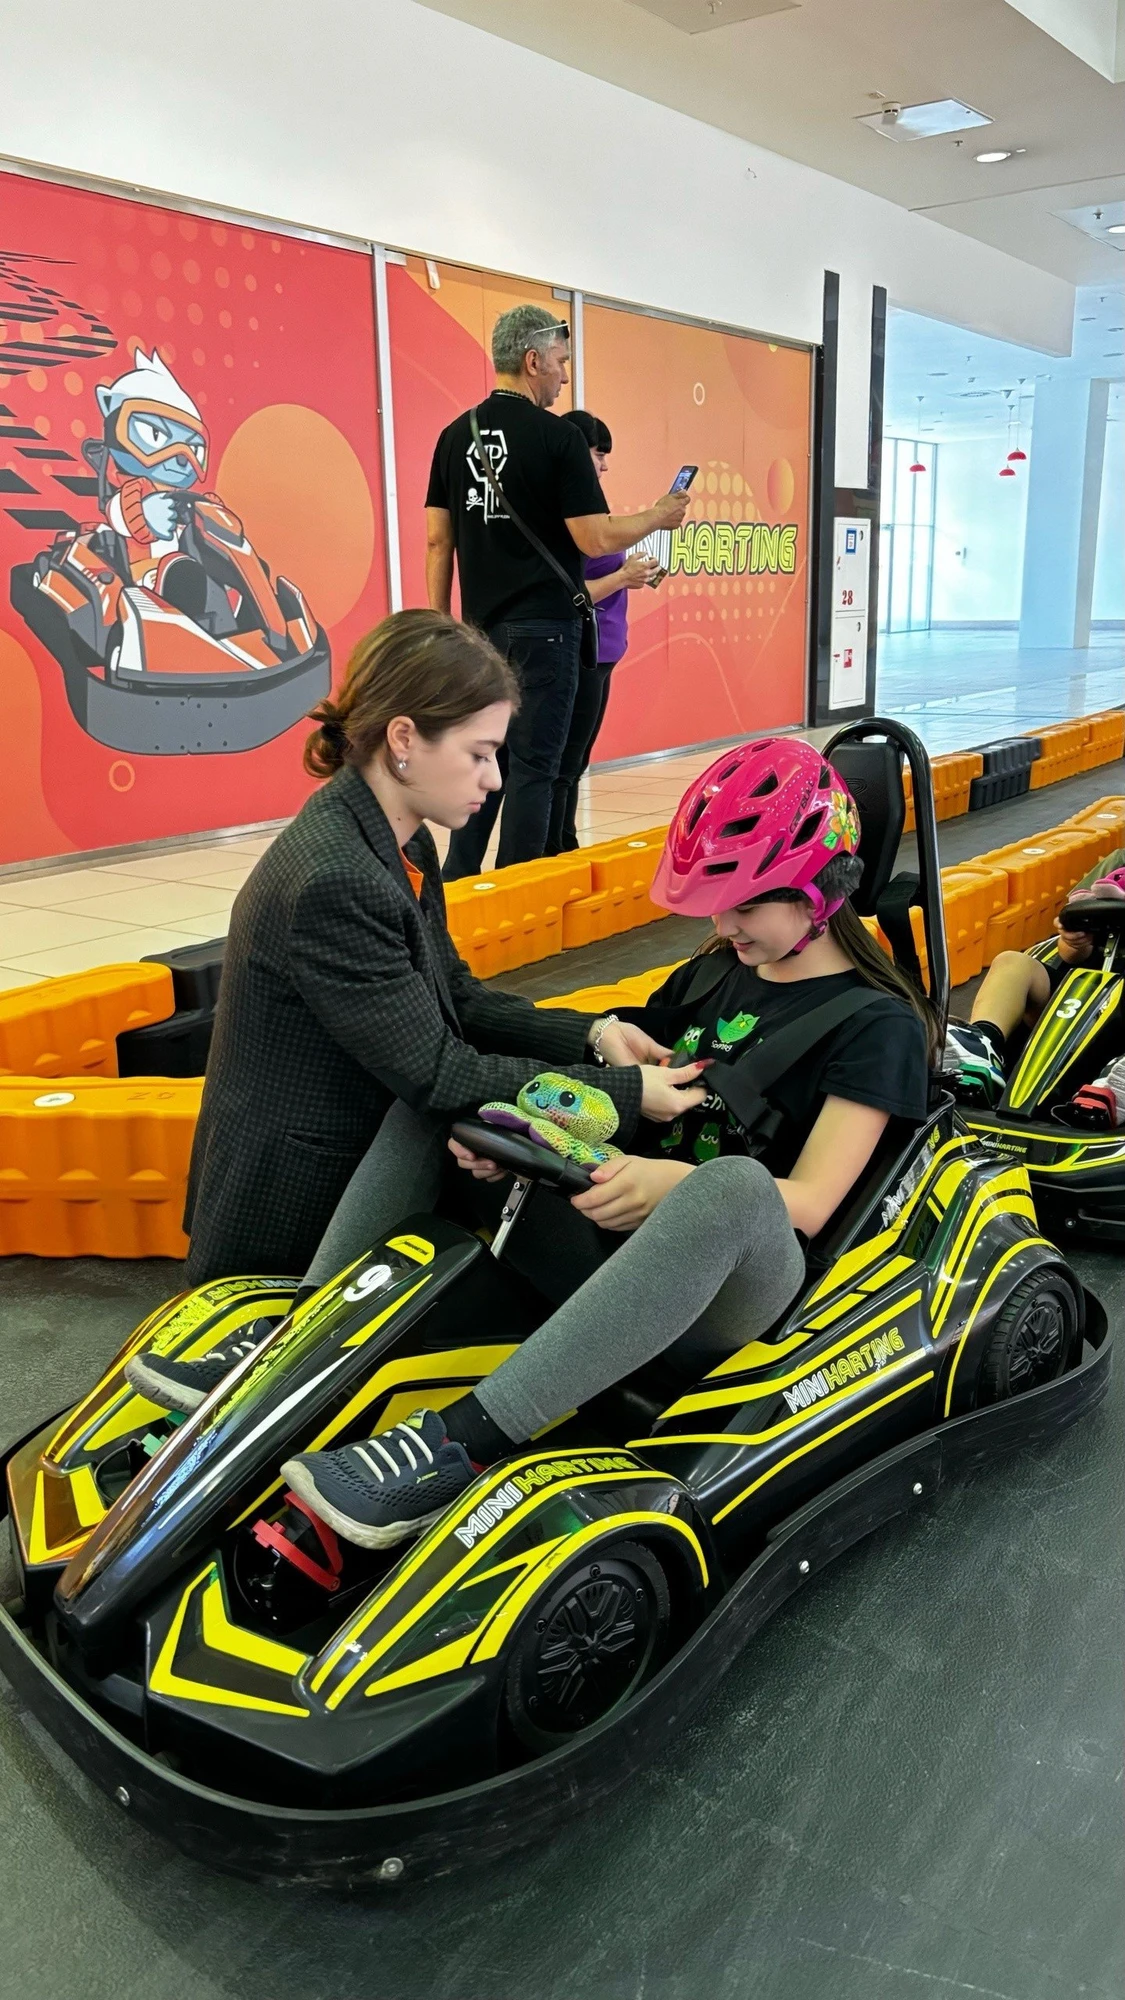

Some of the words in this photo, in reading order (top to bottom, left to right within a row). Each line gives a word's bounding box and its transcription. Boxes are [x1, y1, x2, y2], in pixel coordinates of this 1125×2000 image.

[625, 521, 798, 576] NIKARTING
[842, 590, 853, 605] 28
[1056, 998, 1082, 1019] 3
[343, 1264, 392, 1302] 9
[782, 1327, 906, 1414] MINIKARTING
[454, 1456, 640, 1550] MINIKARTING
